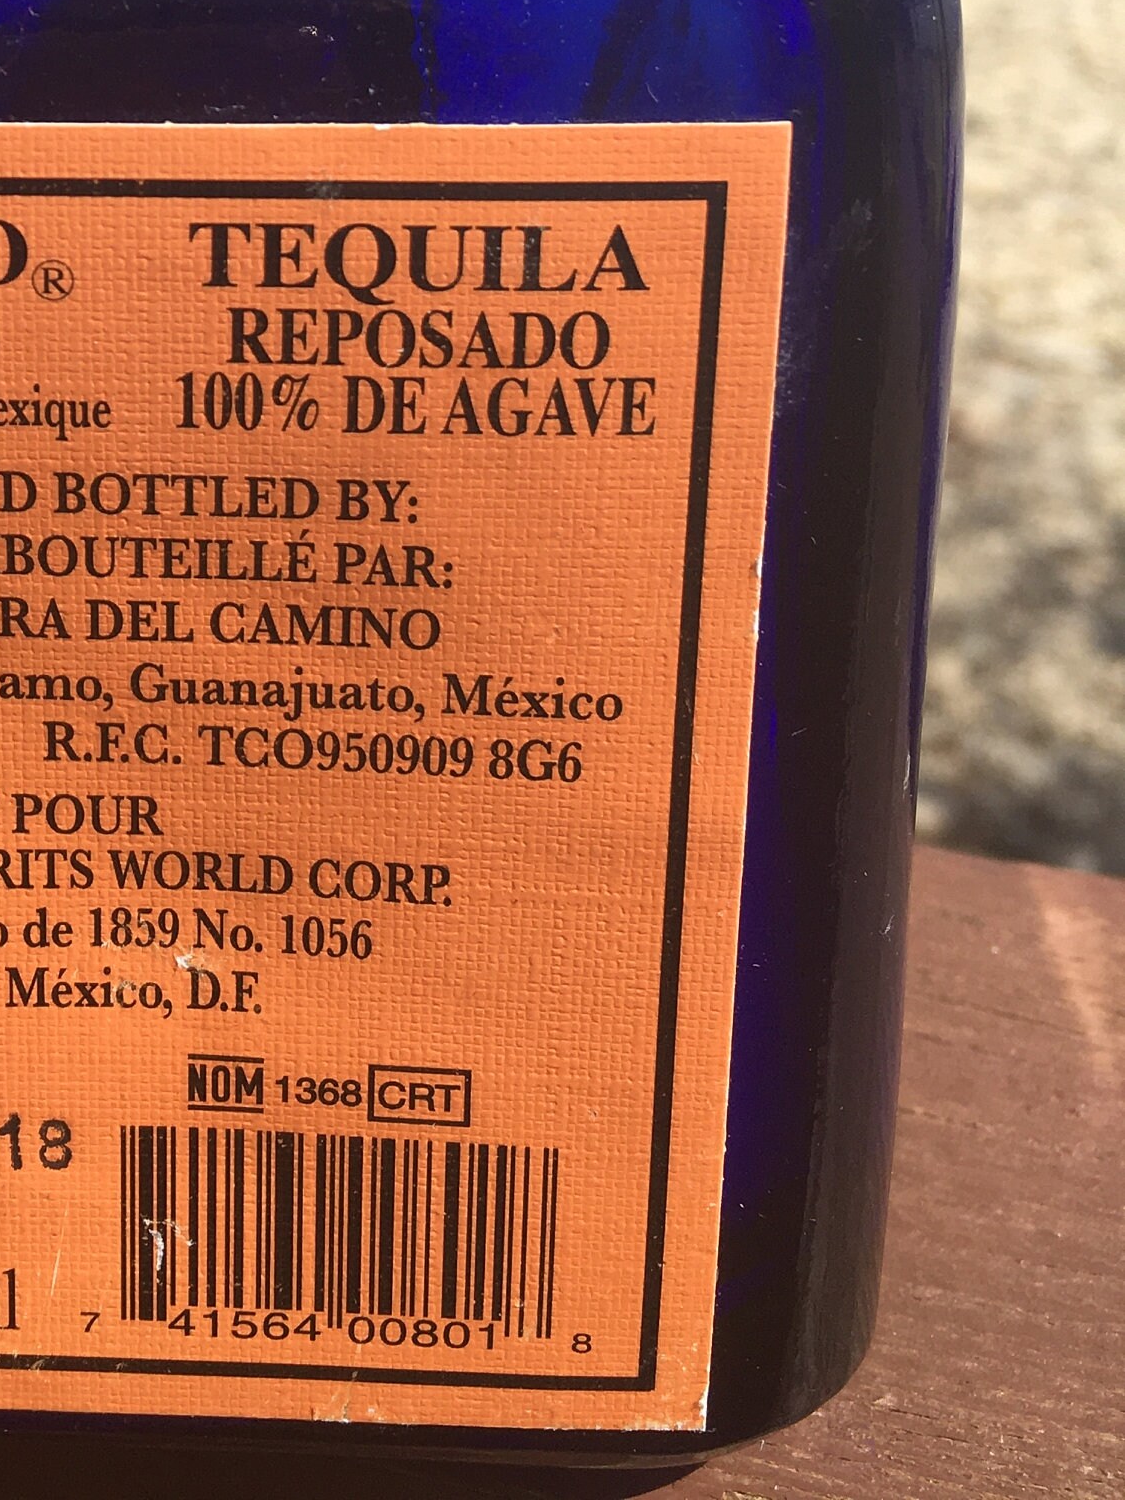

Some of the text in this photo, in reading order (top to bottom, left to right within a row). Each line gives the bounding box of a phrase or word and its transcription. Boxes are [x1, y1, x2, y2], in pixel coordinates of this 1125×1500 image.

[190, 223, 649, 305] TEQUILA
[227, 308, 610, 369] REPOSADO
[177, 372, 655, 436] 100% DE AGAVE
[53, 472, 319, 519] BOTTLED
[336, 480, 417, 523] BY:
[333, 543, 452, 589] PAR:
[86, 600, 193, 642] DEL
[210, 602, 440, 650] CAMINO
[131, 663, 424, 722] Guanajuato,
[442, 674, 622, 721] México
[43, 721, 581, 782] R.F.C. TCO950909 8G6
[12, 794, 164, 835] POUR
[108, 850, 293, 894] WORLD
[309, 859, 451, 906] CORP.
[23, 907, 72, 947] de
[90, 908, 179, 948] 1859
[193, 909, 262, 952] No.
[282, 915, 372, 959] 1056
[5, 967, 172, 1018] México,
[187, 967, 261, 1013] D.F.
[188, 1064, 461, 1113] NOM 1368 CRT
[81, 1308, 591, 1353] 7 41564 00801 8
